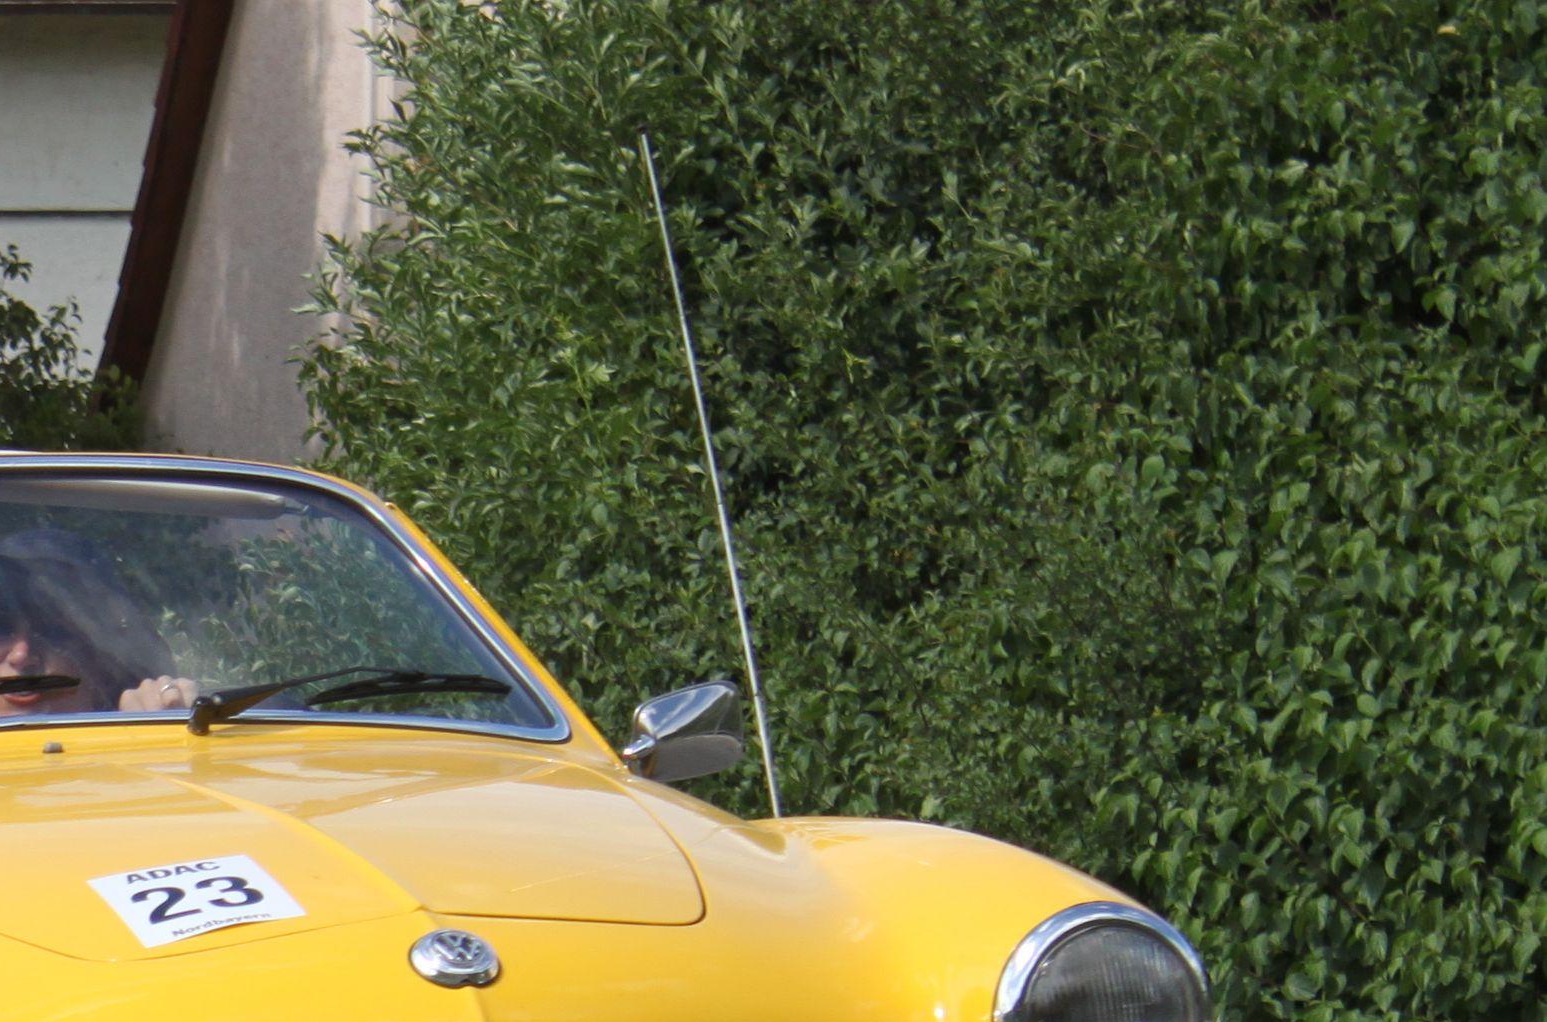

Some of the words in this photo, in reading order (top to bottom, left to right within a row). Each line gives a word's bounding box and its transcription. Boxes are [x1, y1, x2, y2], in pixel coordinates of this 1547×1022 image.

[126, 861, 221, 885] ADAC
[130, 876, 264, 925] 23
[171, 912, 272, 937] Nordbayern
